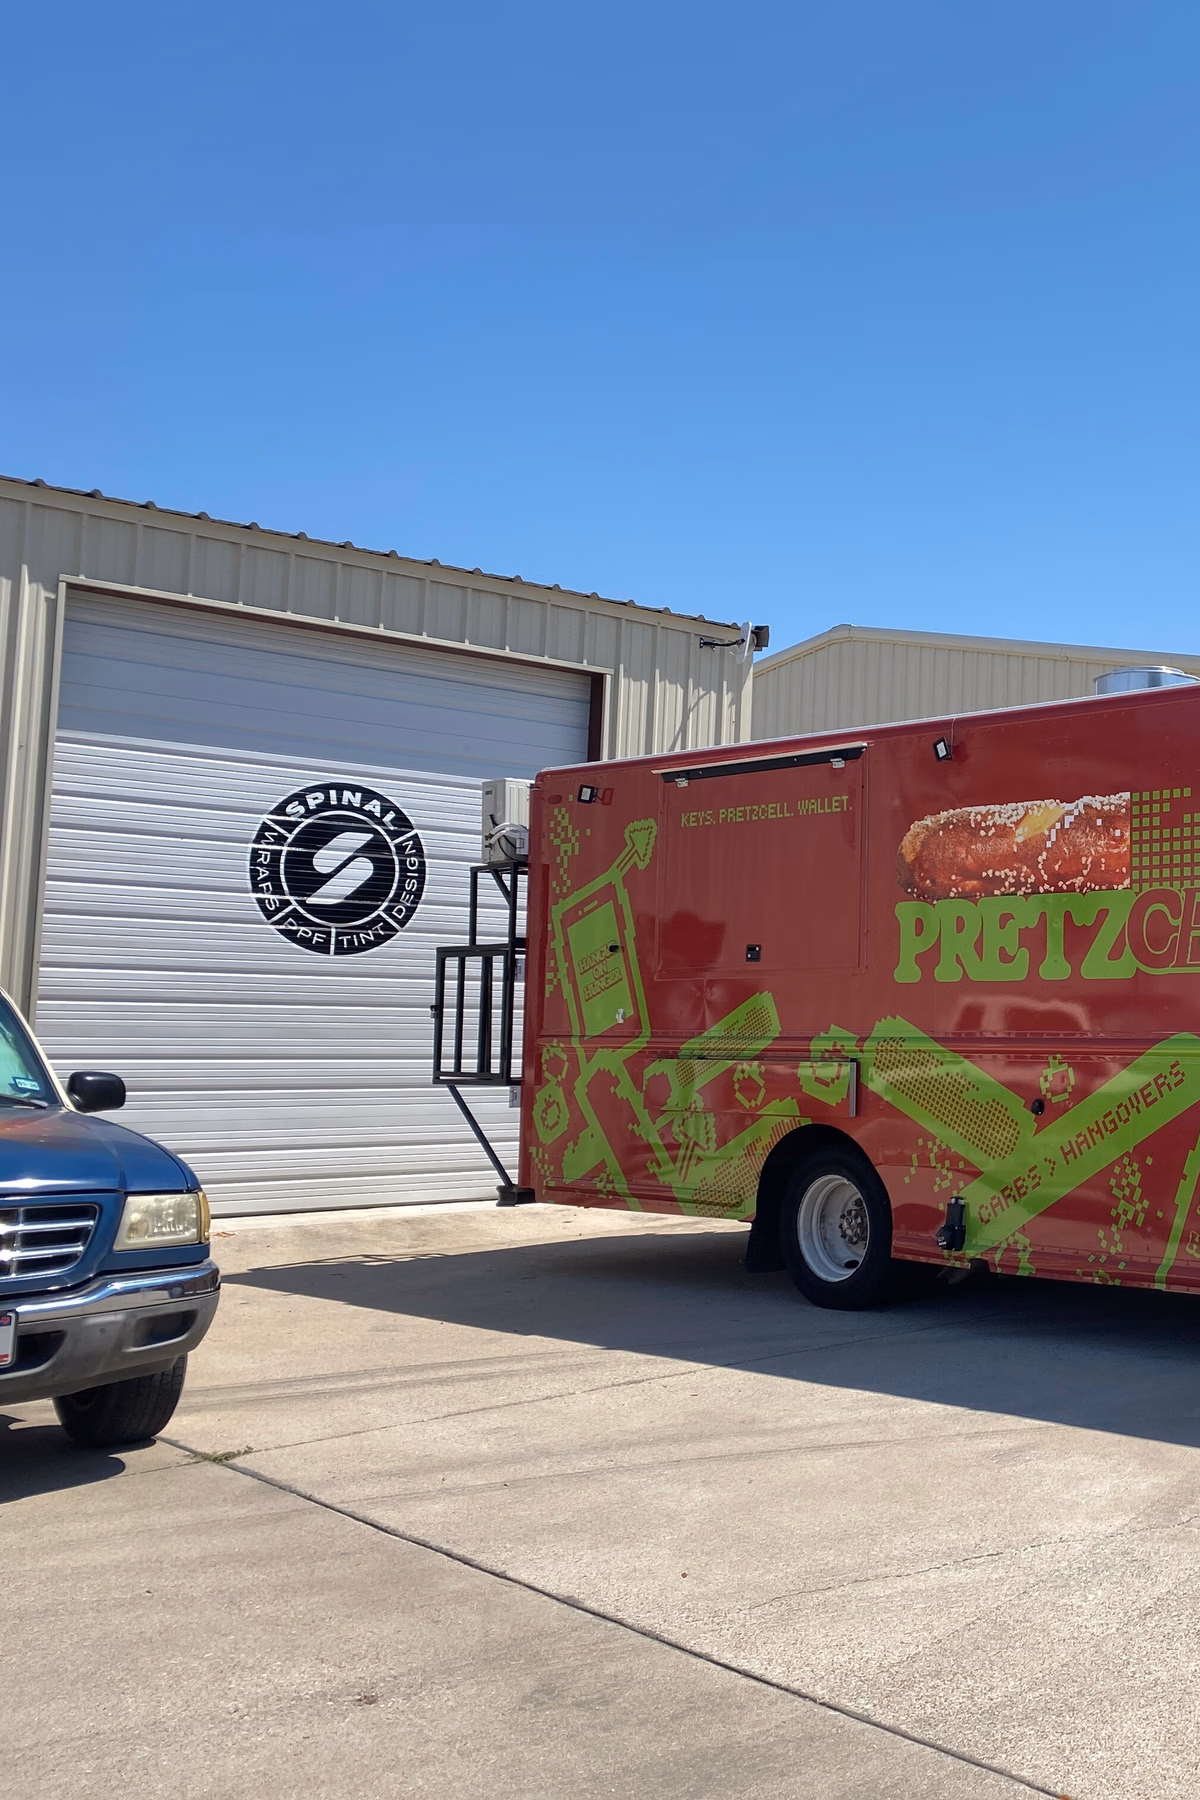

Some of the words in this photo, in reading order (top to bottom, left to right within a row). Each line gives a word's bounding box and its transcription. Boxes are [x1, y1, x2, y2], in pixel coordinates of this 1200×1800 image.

[285, 789, 397, 831] SPINAL
[681, 810, 716, 828] KEYS.
[719, 802, 794, 824] PRETZCELL.
[797, 795, 853, 815] WALLET.
[256, 831, 280, 911] WRAPS
[392, 840, 419, 919] DESIGN
[283, 917, 327, 945] PPF
[338, 922, 386, 948] TINT
[583, 967, 623, 1002] HUNGER
[592, 960, 608, 980] ON
[976, 1164, 1042, 1226] CARBS
[1059, 1060, 1186, 1166] HANGOVERS
